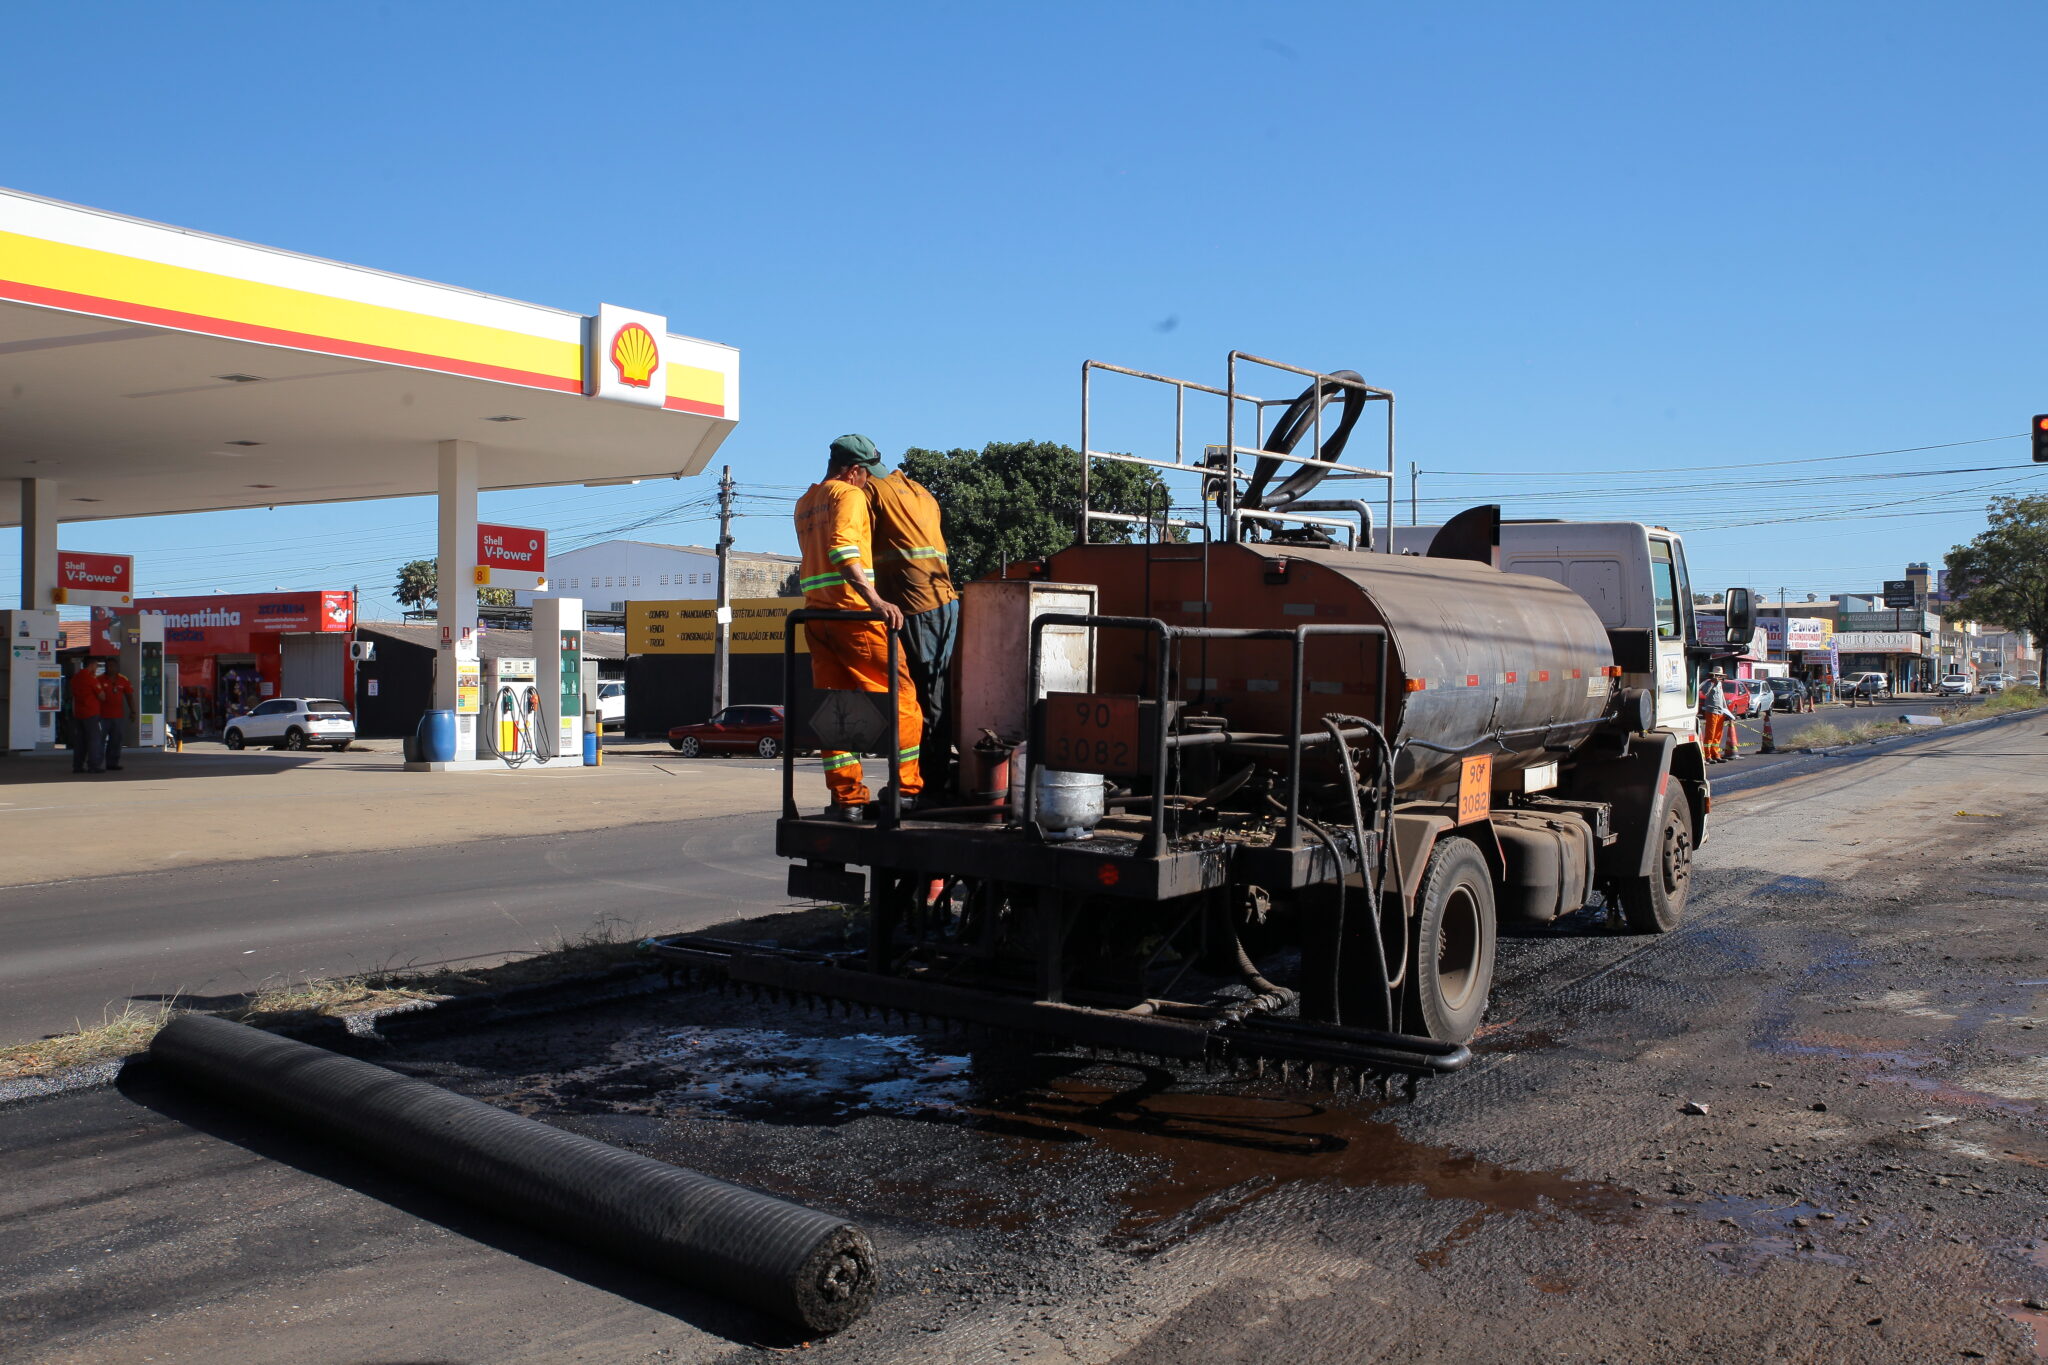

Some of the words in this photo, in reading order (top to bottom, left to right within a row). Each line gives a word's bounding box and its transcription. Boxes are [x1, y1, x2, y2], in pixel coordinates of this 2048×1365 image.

[483, 535, 503, 546] Shell
[484, 546, 533, 561] V-Power
[65, 561, 86, 570] Shell
[66, 570, 118, 584] V-Power
[476, 570, 484, 582] 8
[649, 610, 669, 619] COMPRA
[649, 625, 664, 633] VENDA
[762, 631, 769, 640] DE
[1876, 633, 1910, 646] SOM
[649, 638, 665, 647] TROCA
[1076, 702, 1111, 729] 90
[1057, 736, 1129, 767] 3082
[1461, 791, 1487, 815] 3082
